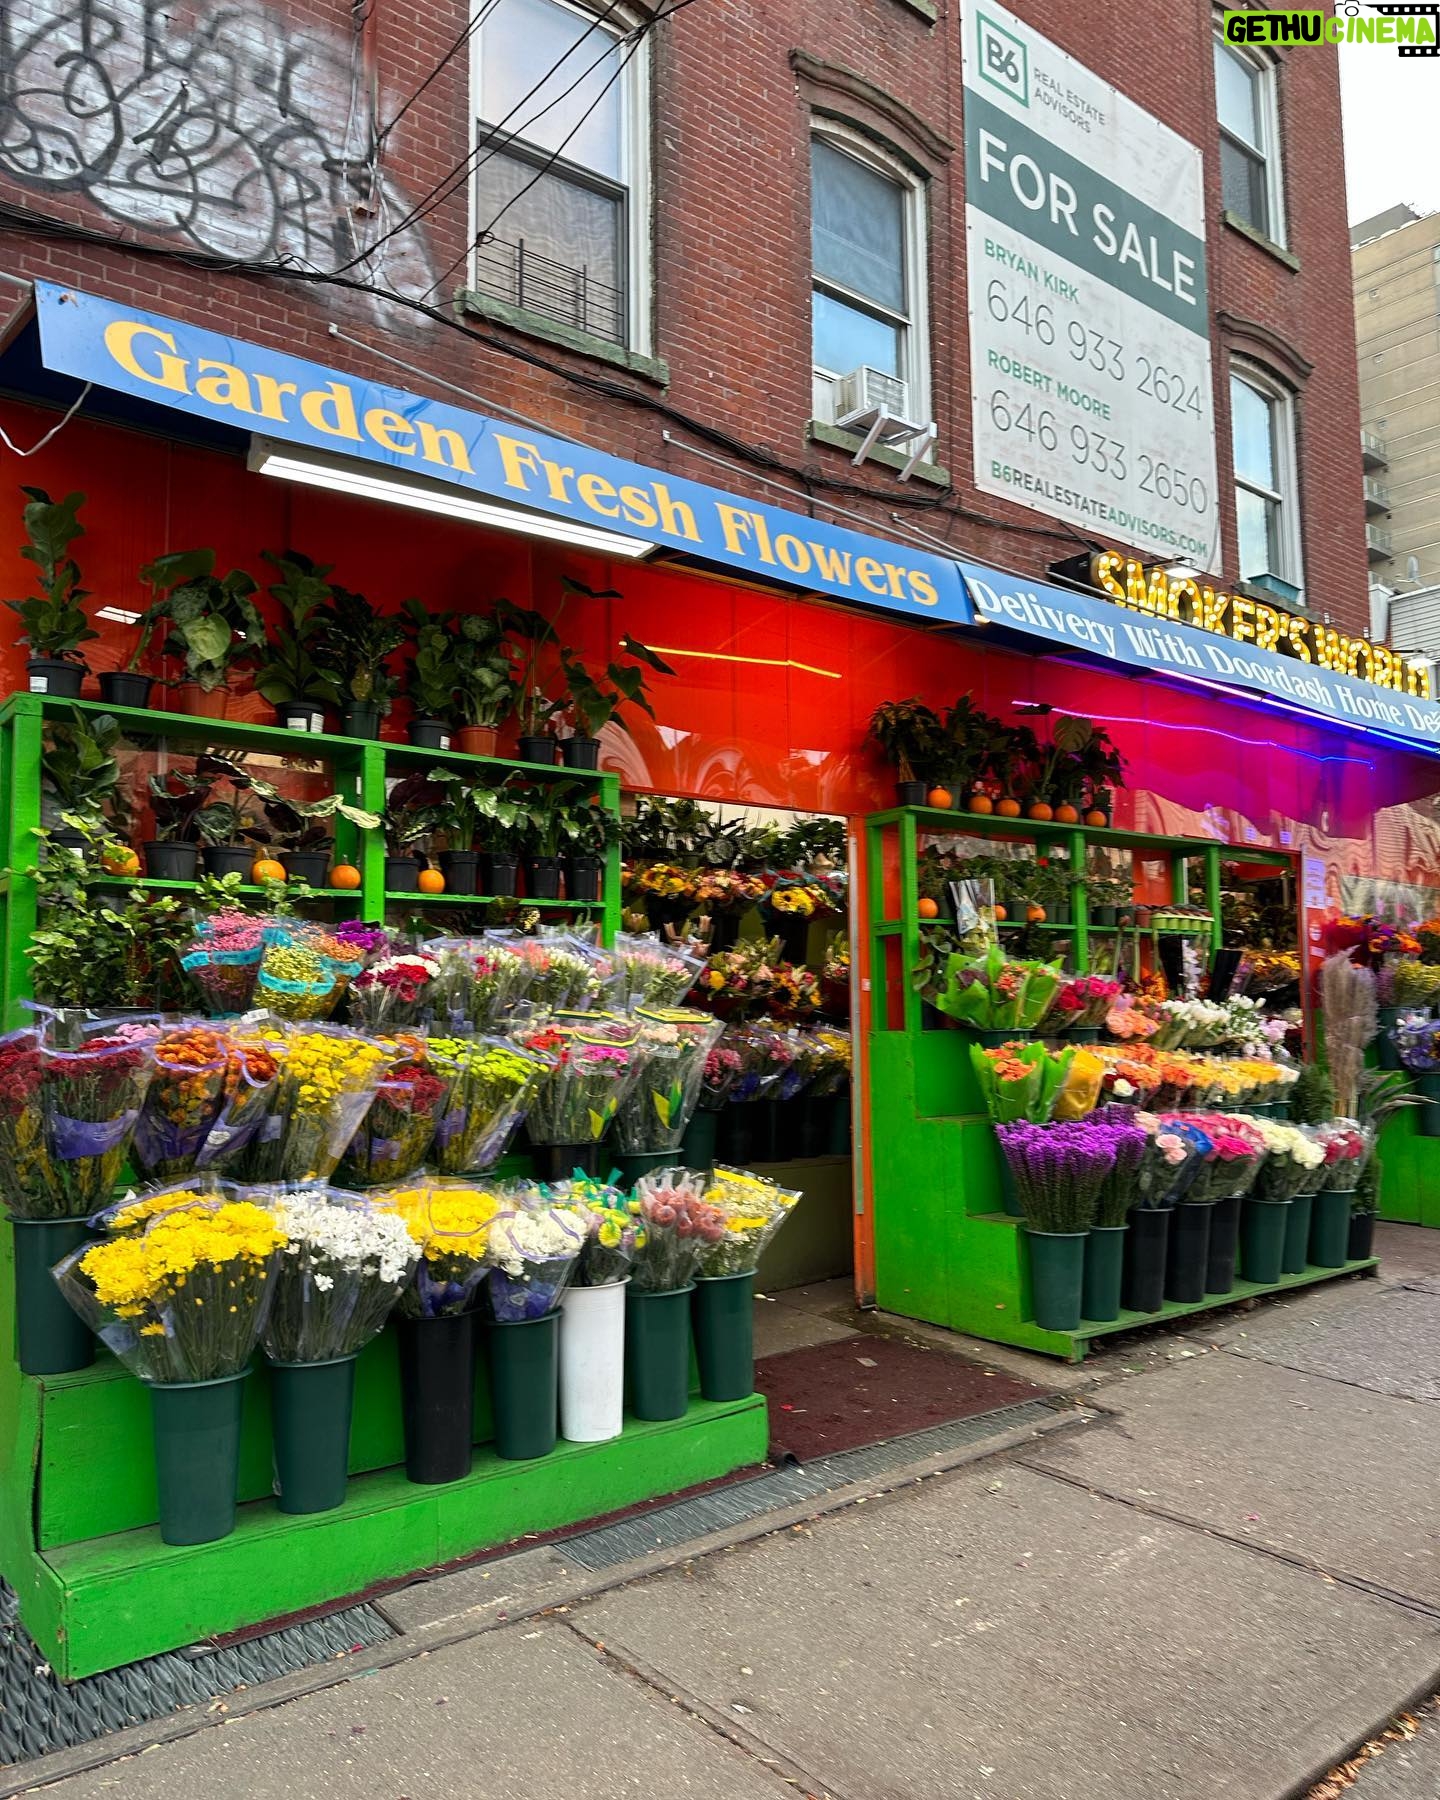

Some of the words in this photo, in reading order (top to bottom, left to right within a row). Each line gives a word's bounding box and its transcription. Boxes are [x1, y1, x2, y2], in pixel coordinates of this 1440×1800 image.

[986, 33, 1020, 84] B6
[1033, 67, 1064, 98] REAL
[1066, 86, 1106, 126] ESTATE
[1033, 87, 1092, 134] ADVISORS
[978, 128, 1079, 236] FOR
[1092, 203, 1197, 306] SALE
[984, 238, 1039, 281] BRYAN
[1043, 270, 1080, 305] KIRK
[987, 279, 1055, 346] 646
[1067, 320, 1125, 381] 933
[1135, 356, 1204, 420] 2624
[987, 349, 1053, 393] ROBERT
[1056, 381, 1111, 422] MOORE
[104, 320, 477, 476] Garden
[491, 432, 704, 543] Fresh
[714, 502, 939, 607] Flowers
[990, 389, 1058, 452] 646
[1070, 424, 1127, 481] 933
[1137, 454, 1208, 514] 2650
[991, 460, 1208, 559] B6REALESTATEADVISORS.COM
[964, 576, 1116, 659] Delivery
[1121, 622, 1207, 671] With
[1203, 643, 1336, 710] Doordash
[1334, 683, 1406, 727] Home
[1096, 550, 1311, 664] SMOKER'S
